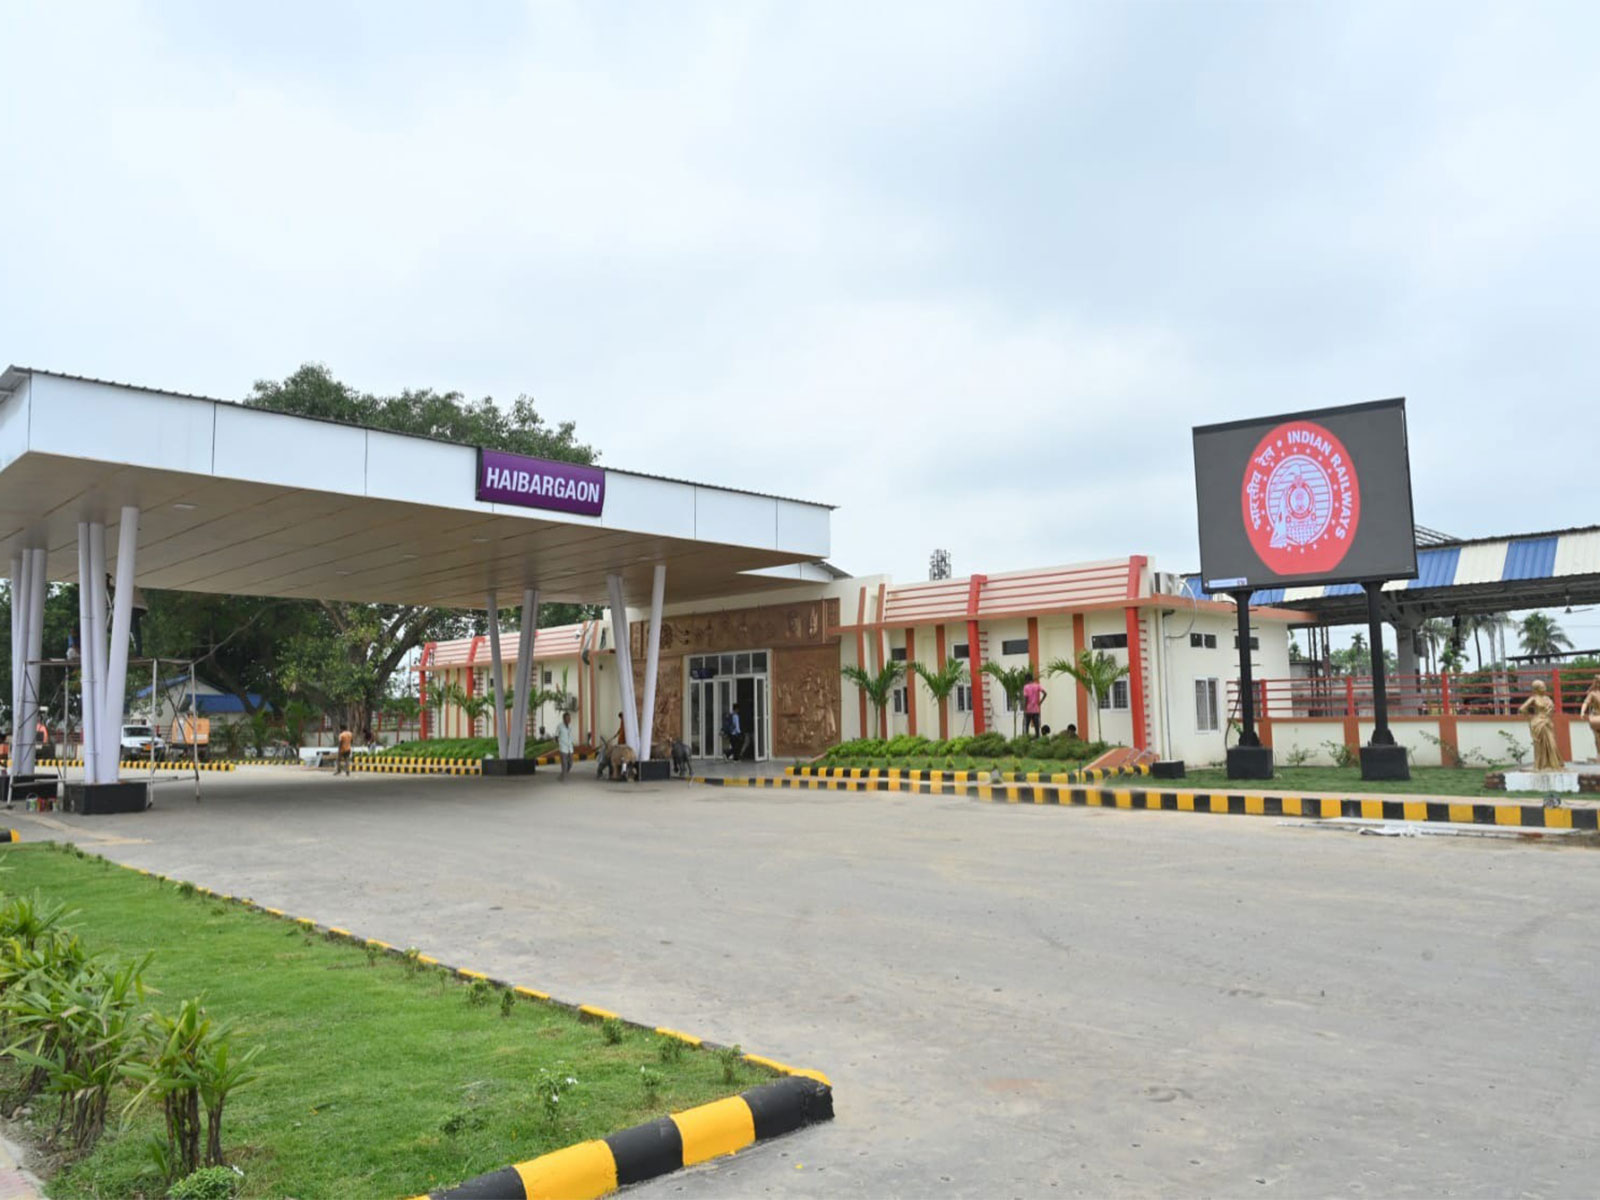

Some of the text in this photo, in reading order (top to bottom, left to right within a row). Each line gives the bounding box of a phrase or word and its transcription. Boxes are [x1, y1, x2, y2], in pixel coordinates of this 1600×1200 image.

[486, 466, 600, 503] HAIBARGAON
[1246, 446, 1275, 531] भारतीय रेल
[1287, 430, 1352, 539] INDIAN RAILWAYS
